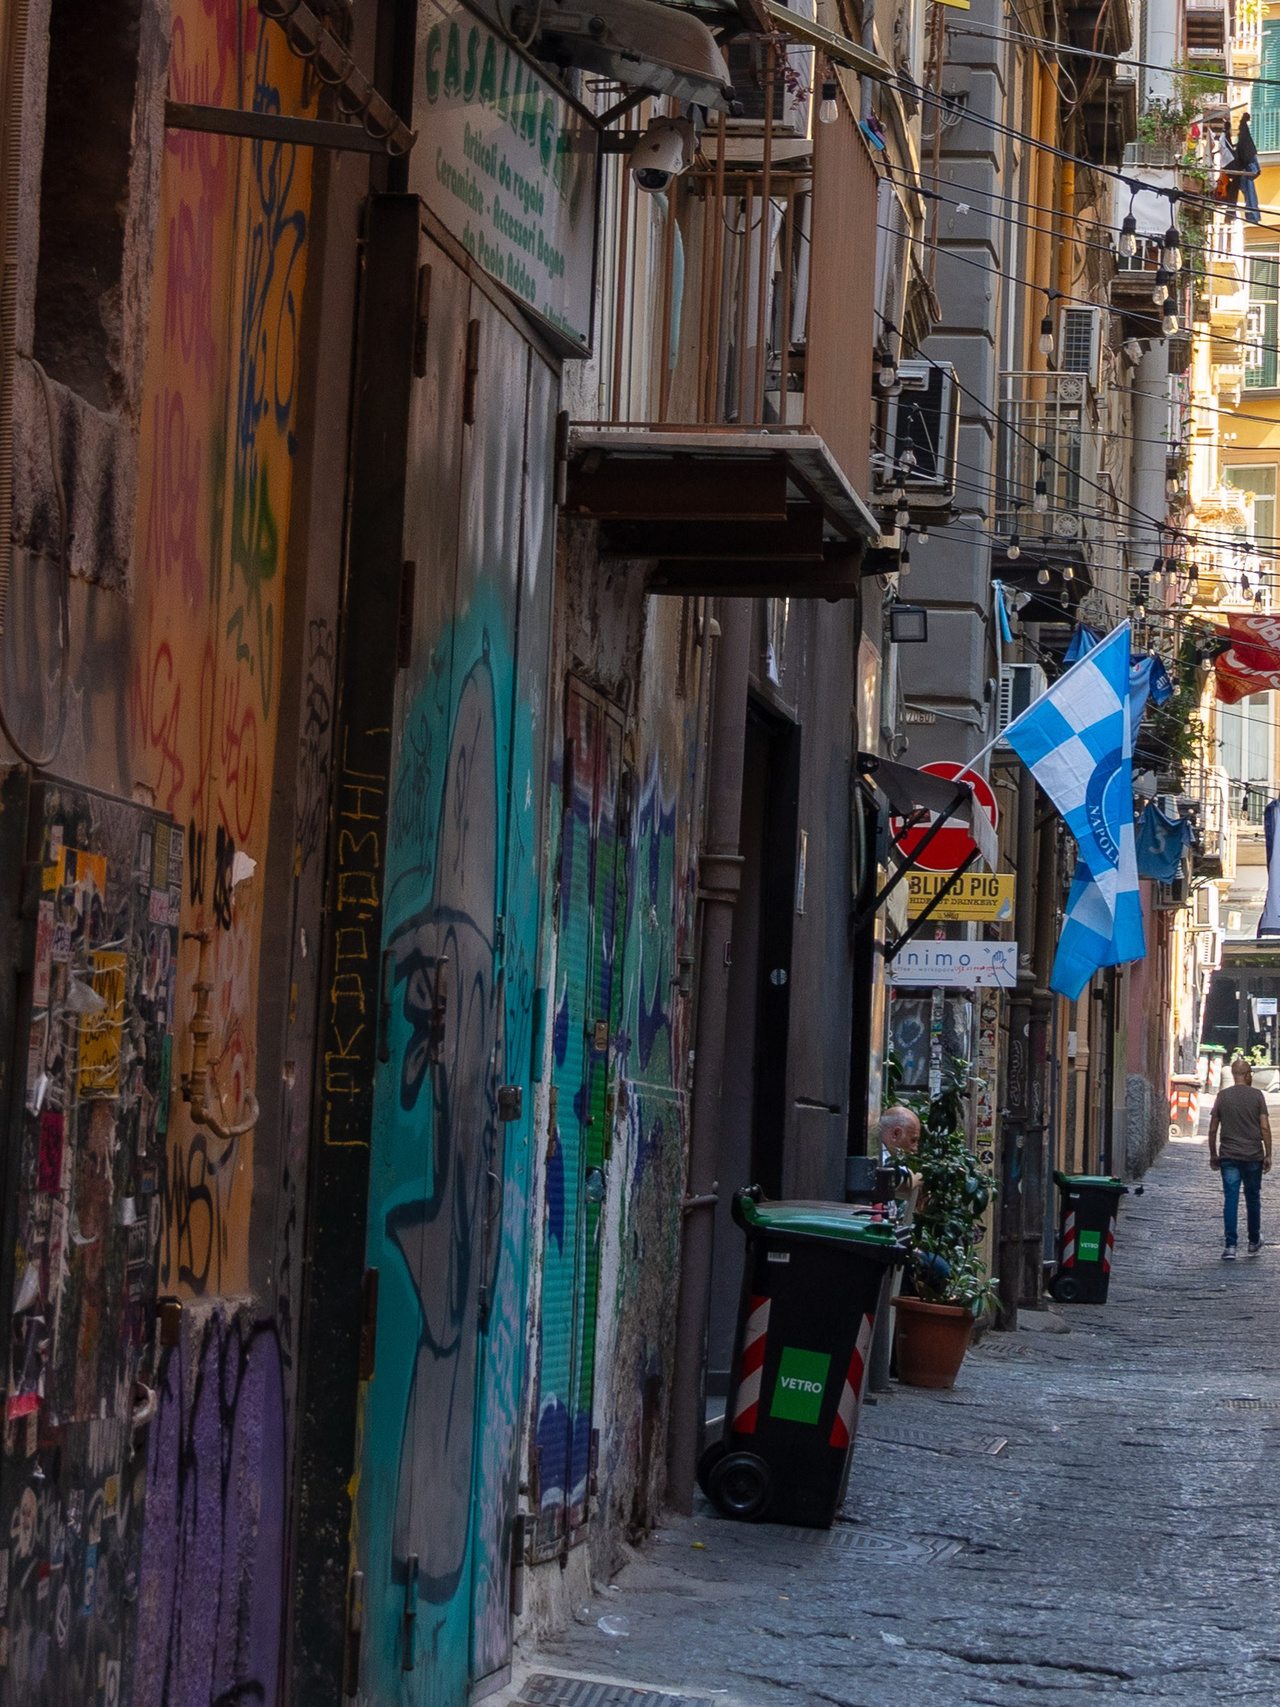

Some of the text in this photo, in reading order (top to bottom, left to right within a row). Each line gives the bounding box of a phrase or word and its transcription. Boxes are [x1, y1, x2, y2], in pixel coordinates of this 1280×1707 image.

[436, 147, 484, 216] Ceramiche
[493, 194, 535, 256] Accessori
[514, 172, 544, 216] regalo
[1148, 826, 1168, 854] 3
[970, 877, 999, 897] PIG
[951, 898, 998, 906] DRINKERY
[780, 1375, 822, 1394] VETRO
